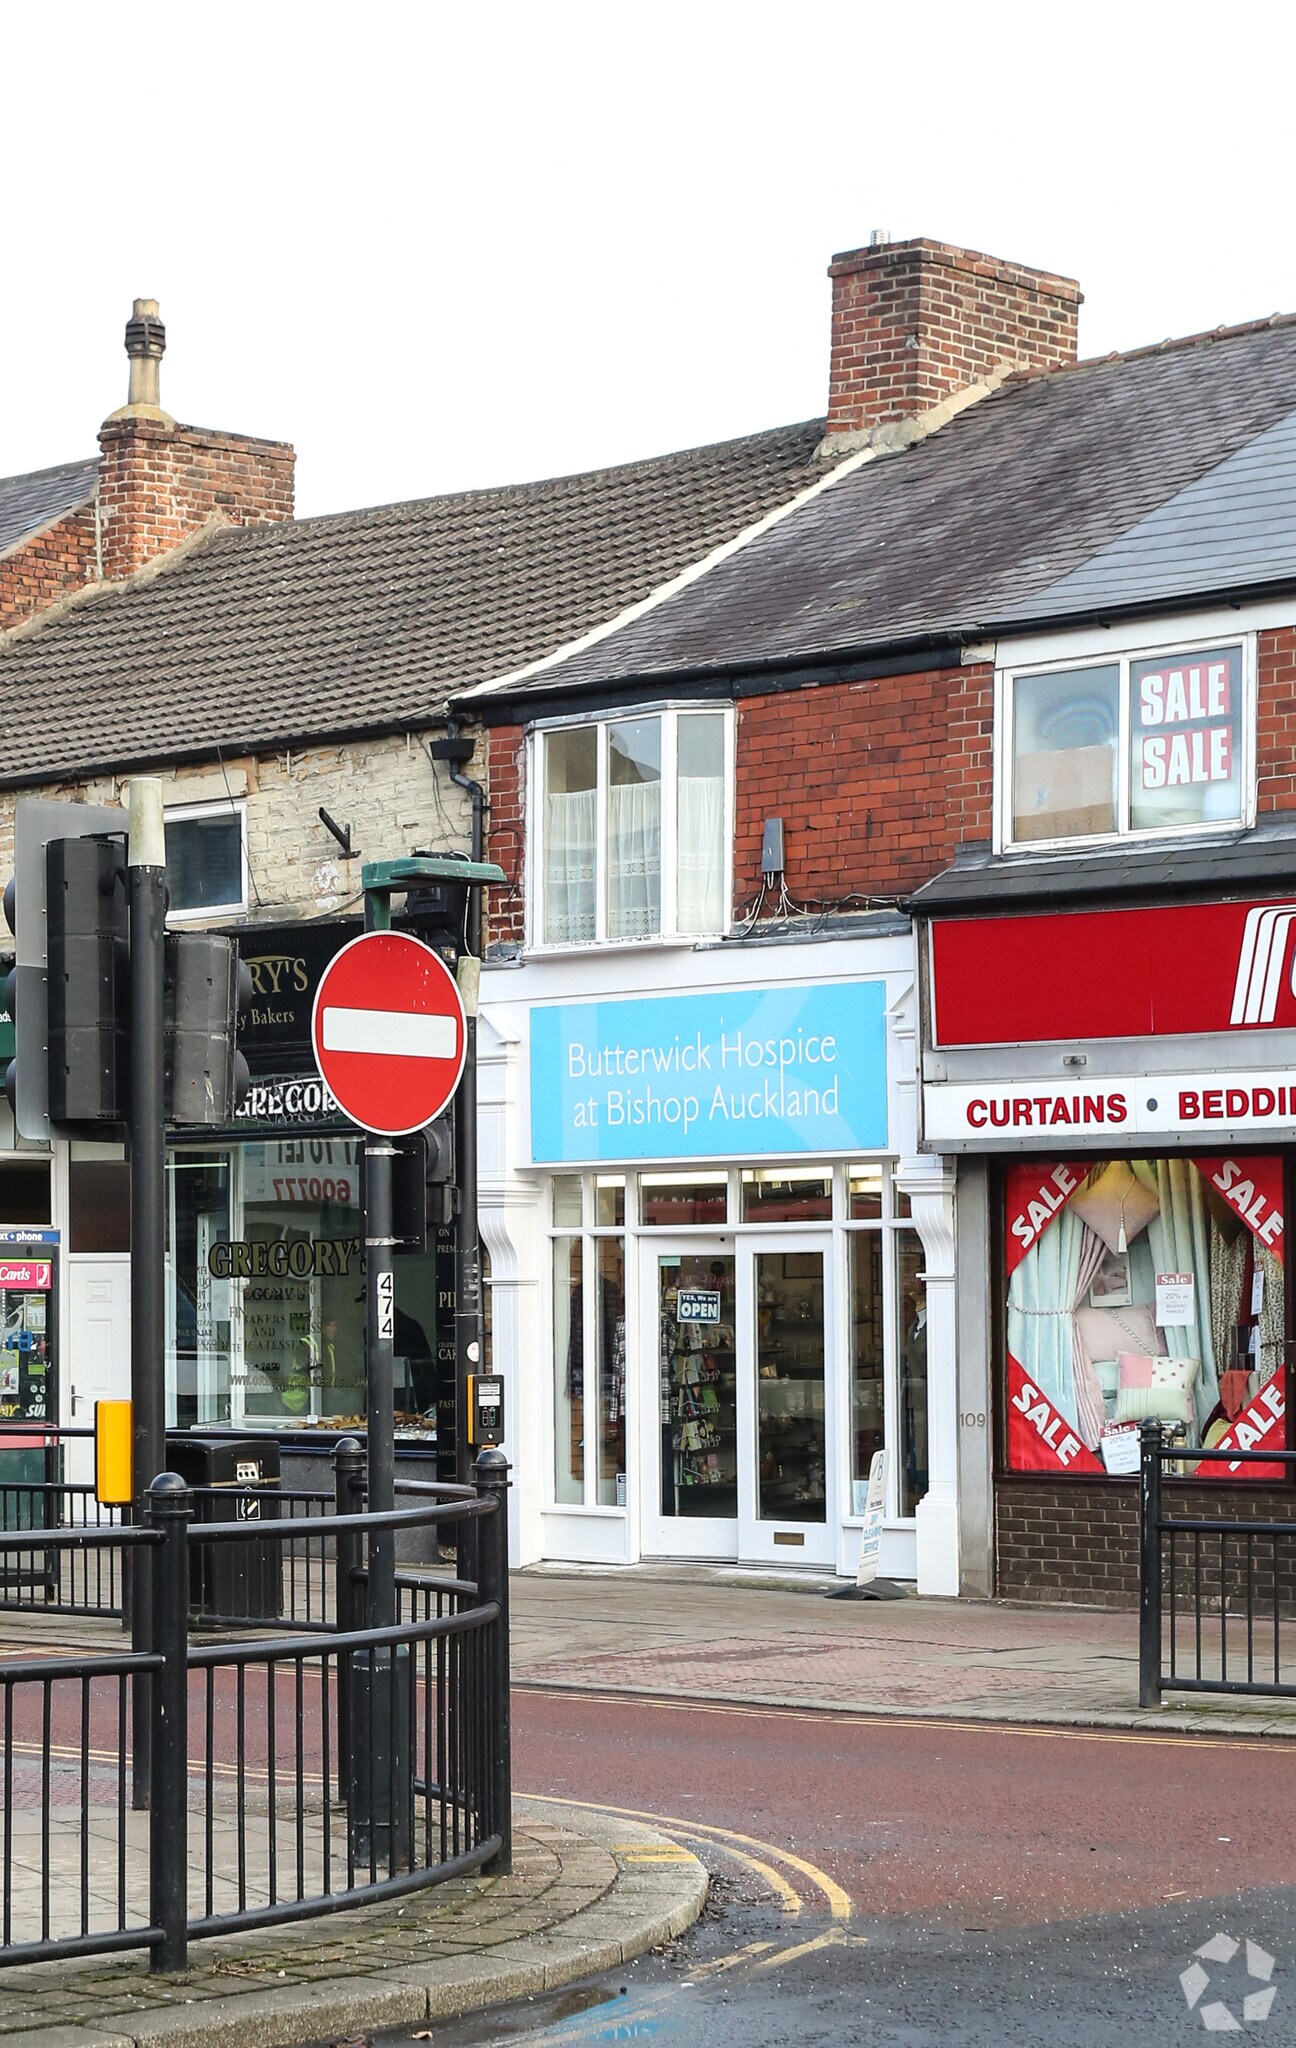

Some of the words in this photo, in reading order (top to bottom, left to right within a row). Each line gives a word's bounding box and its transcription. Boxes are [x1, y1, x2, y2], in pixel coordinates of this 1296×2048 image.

[1141, 664, 1225, 726] SALE
[1143, 728, 1227, 788] SALE
[250, 1007, 295, 1025] Bakers
[568, 1031, 712, 1078] Butterwick
[721, 1026, 837, 1079] Hospice
[573, 1096, 599, 1128] at
[607, 1086, 700, 1135] Bishop
[708, 1074, 839, 1121] Auckland
[966, 1093, 1128, 1128] CURTAINS
[1011, 1163, 1077, 1249] SALE
[1212, 1160, 1284, 1246] SALE
[16, 1231, 43, 1243] phone
[0, 1266, 31, 1281] Cards
[1161, 1274, 1188, 1285] Sale
[1164, 1292, 1181, 1300] 20%
[681, 1302, 717, 1318] OPEN
[959, 1412, 986, 1427] 109
[1011, 1383, 1082, 1467] SALE
[1104, 1424, 1131, 1437] Sale
